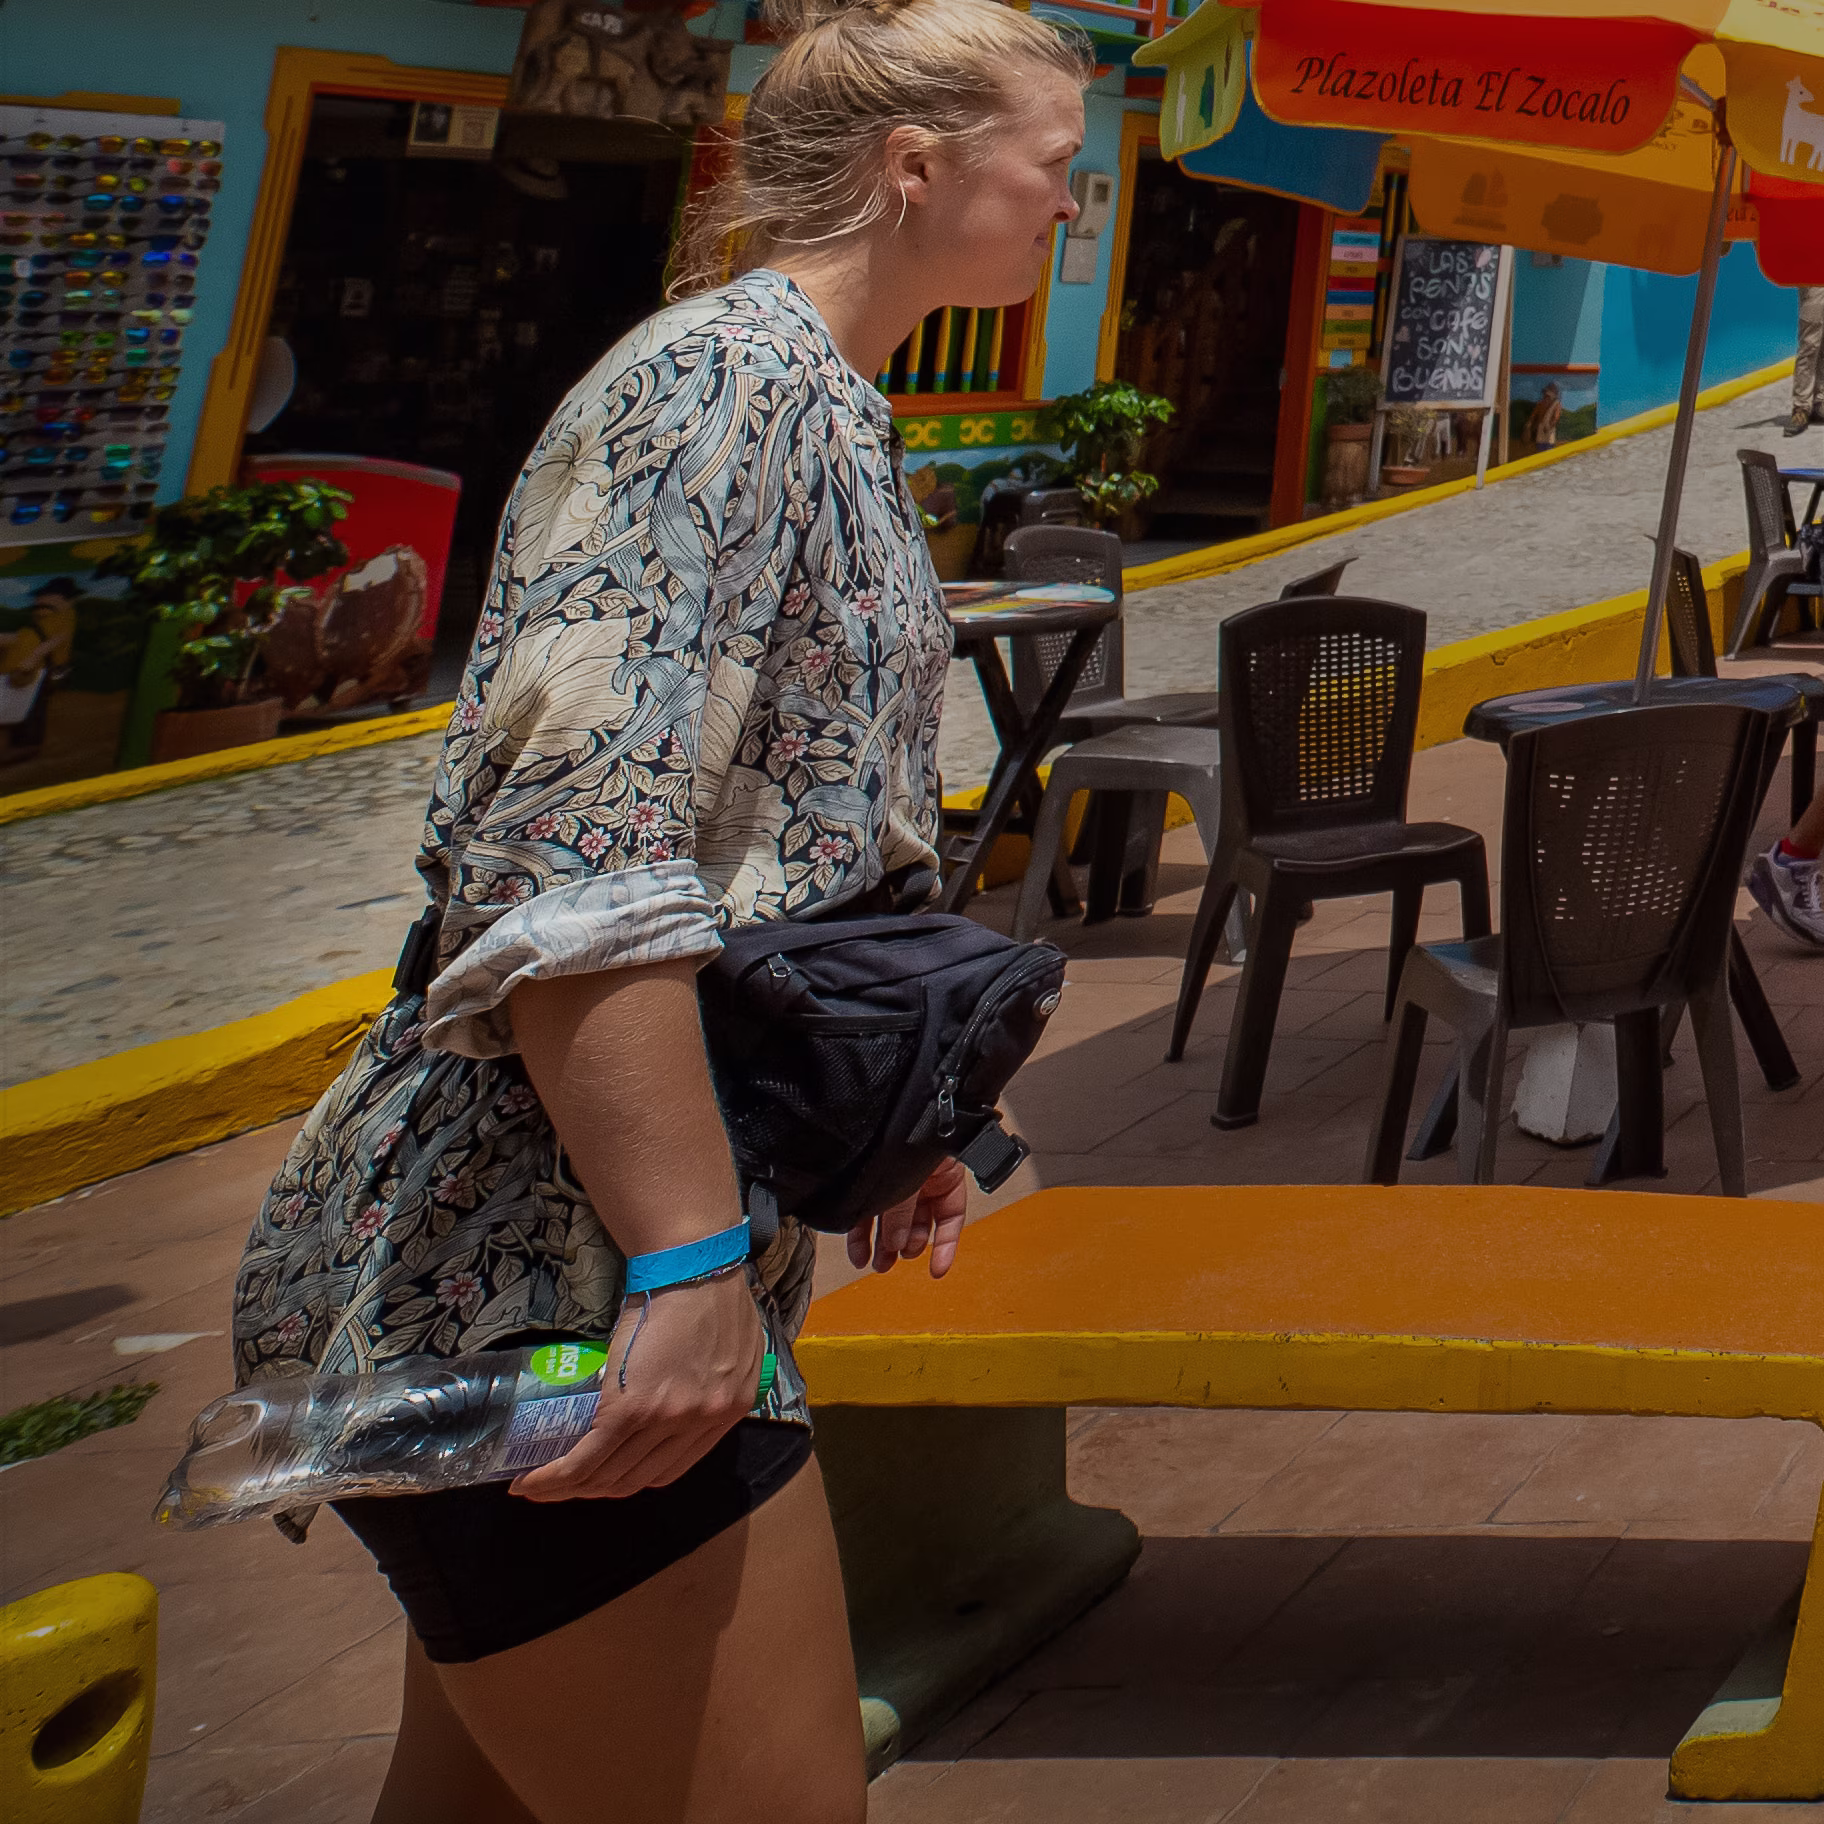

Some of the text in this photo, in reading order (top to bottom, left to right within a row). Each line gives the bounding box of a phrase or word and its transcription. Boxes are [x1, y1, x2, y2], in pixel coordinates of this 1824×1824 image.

[1290, 52, 1632, 125] Plazoleta El Zocalo
[1428, 250, 1468, 275] LAS
